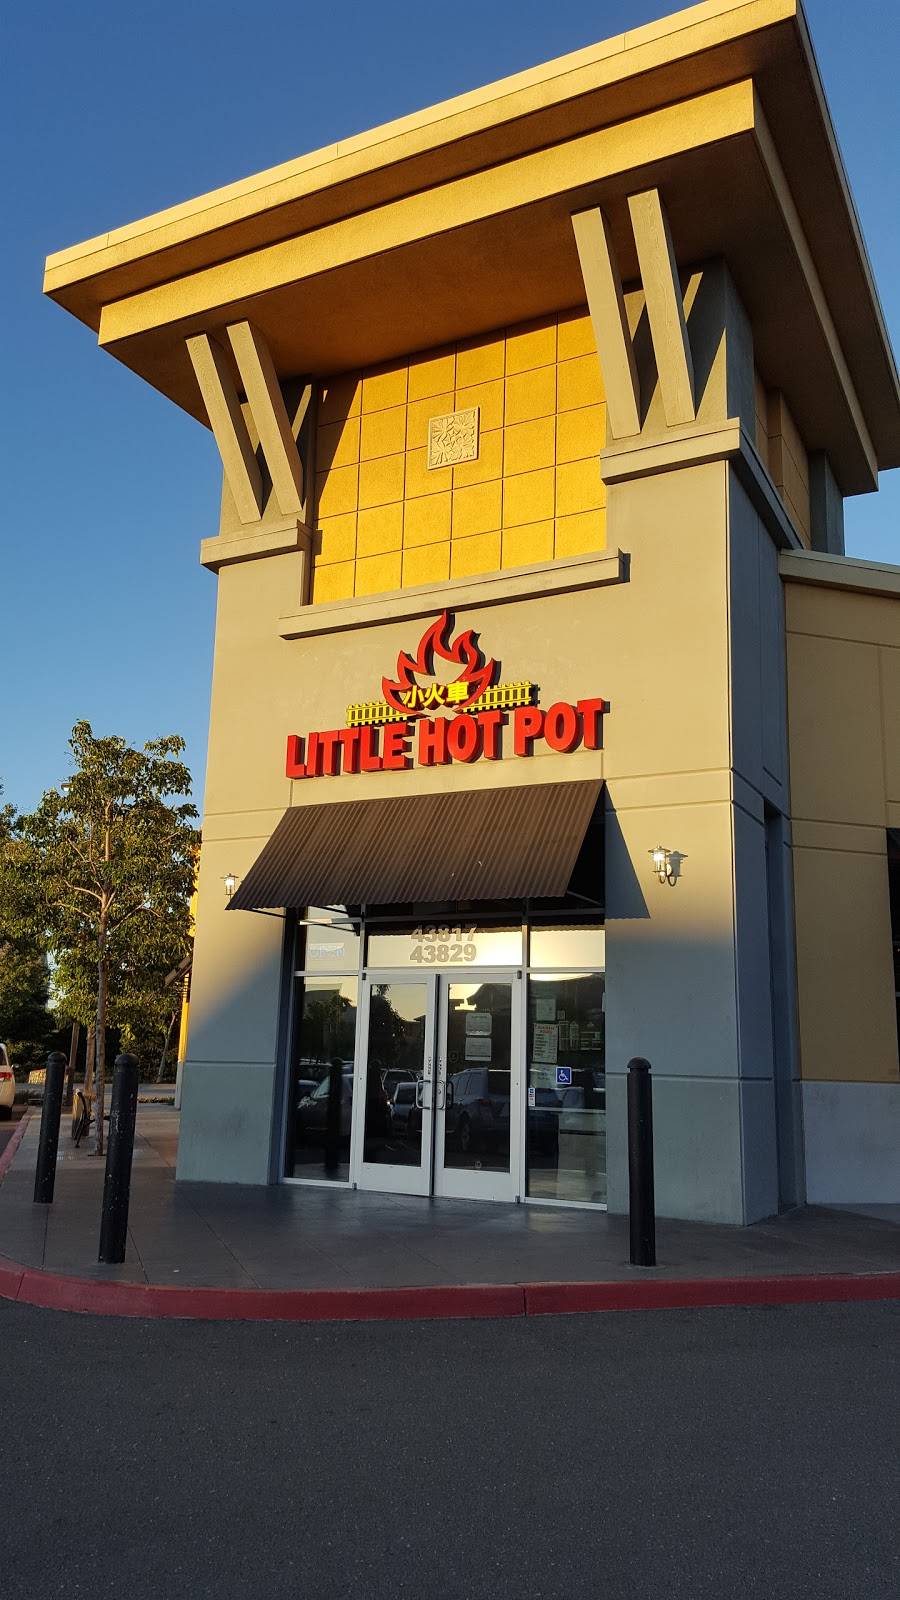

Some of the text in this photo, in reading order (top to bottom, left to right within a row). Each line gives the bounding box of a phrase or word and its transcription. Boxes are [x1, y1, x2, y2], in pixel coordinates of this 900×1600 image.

[403, 681, 469, 708] 小火車
[286, 698, 609, 779] LITTLE HOT POT
[411, 923, 477, 942] 43817
[410, 944, 476, 963] 43829
